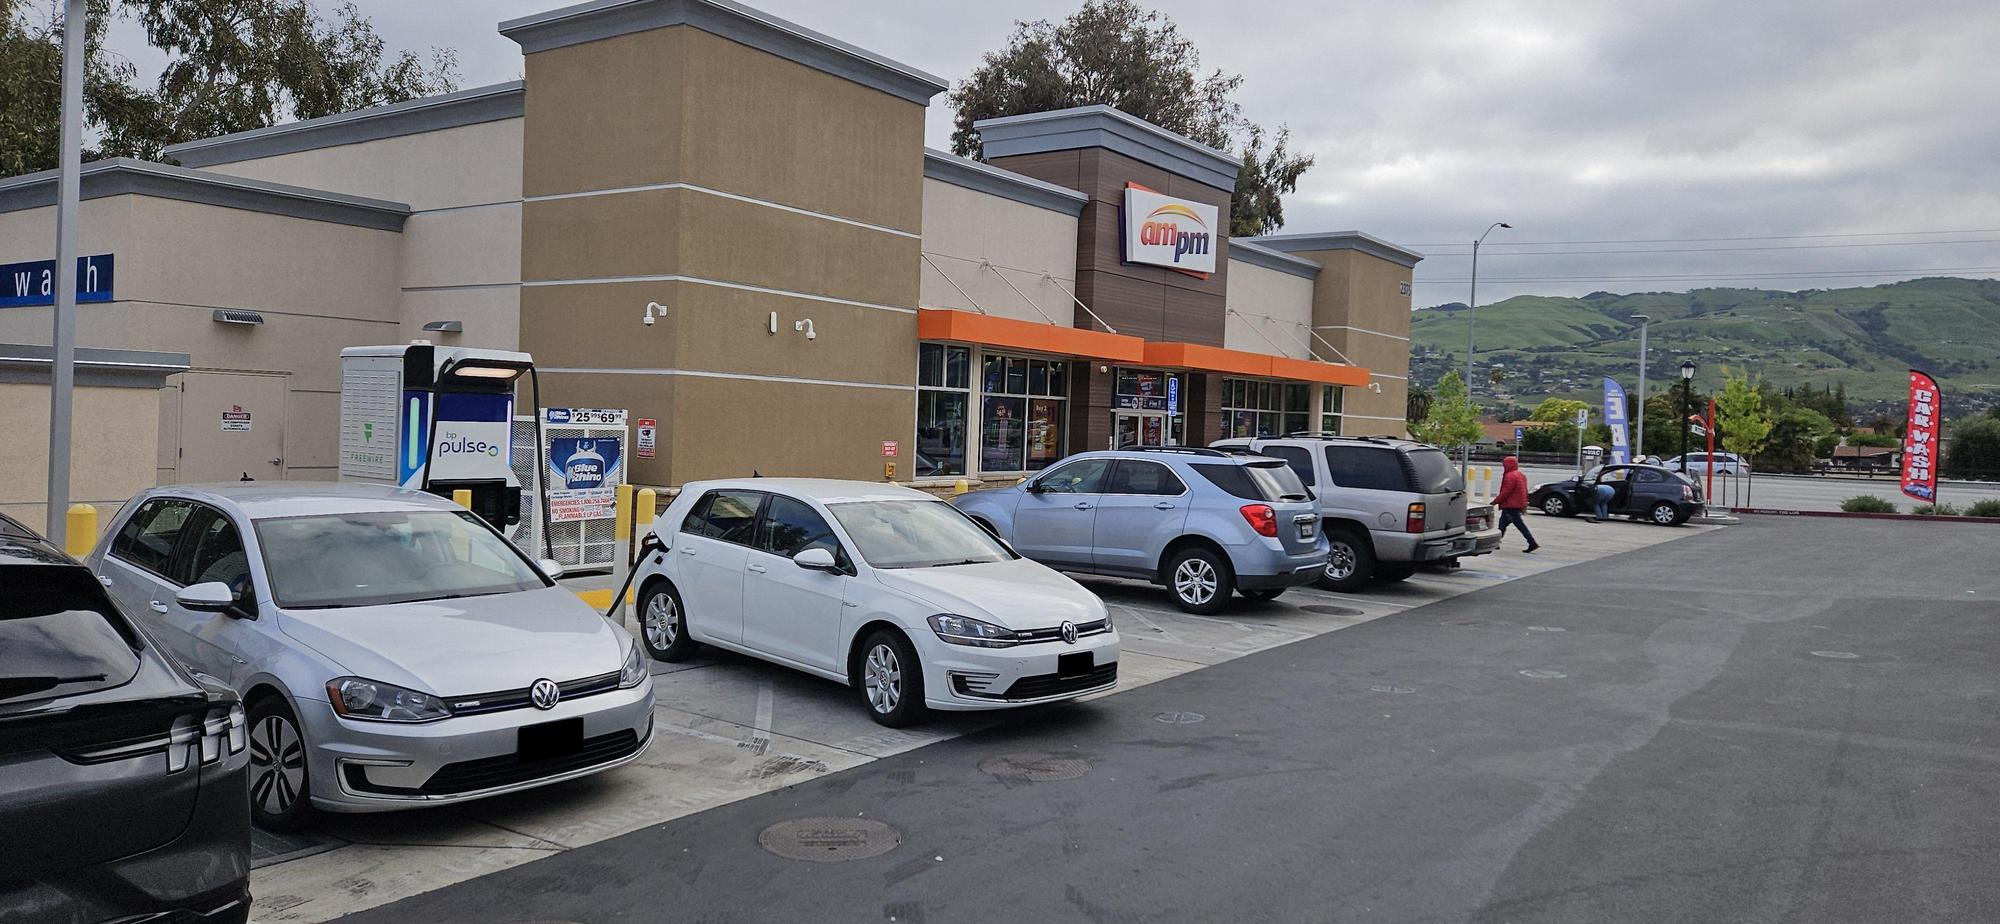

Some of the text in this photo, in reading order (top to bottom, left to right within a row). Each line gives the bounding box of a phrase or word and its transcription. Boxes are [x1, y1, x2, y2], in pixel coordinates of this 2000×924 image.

[1141, 221, 1209, 262] ampm
[15, 256, 98, 297] wah
[1914, 389, 1933, 428] CAR
[439, 437, 487, 457] pulse
[446, 431, 457, 440] bp
[350, 453, 384, 464] FREEWIRE
[574, 464, 598, 472] Blue
[1910, 430, 1931, 480] WASH
